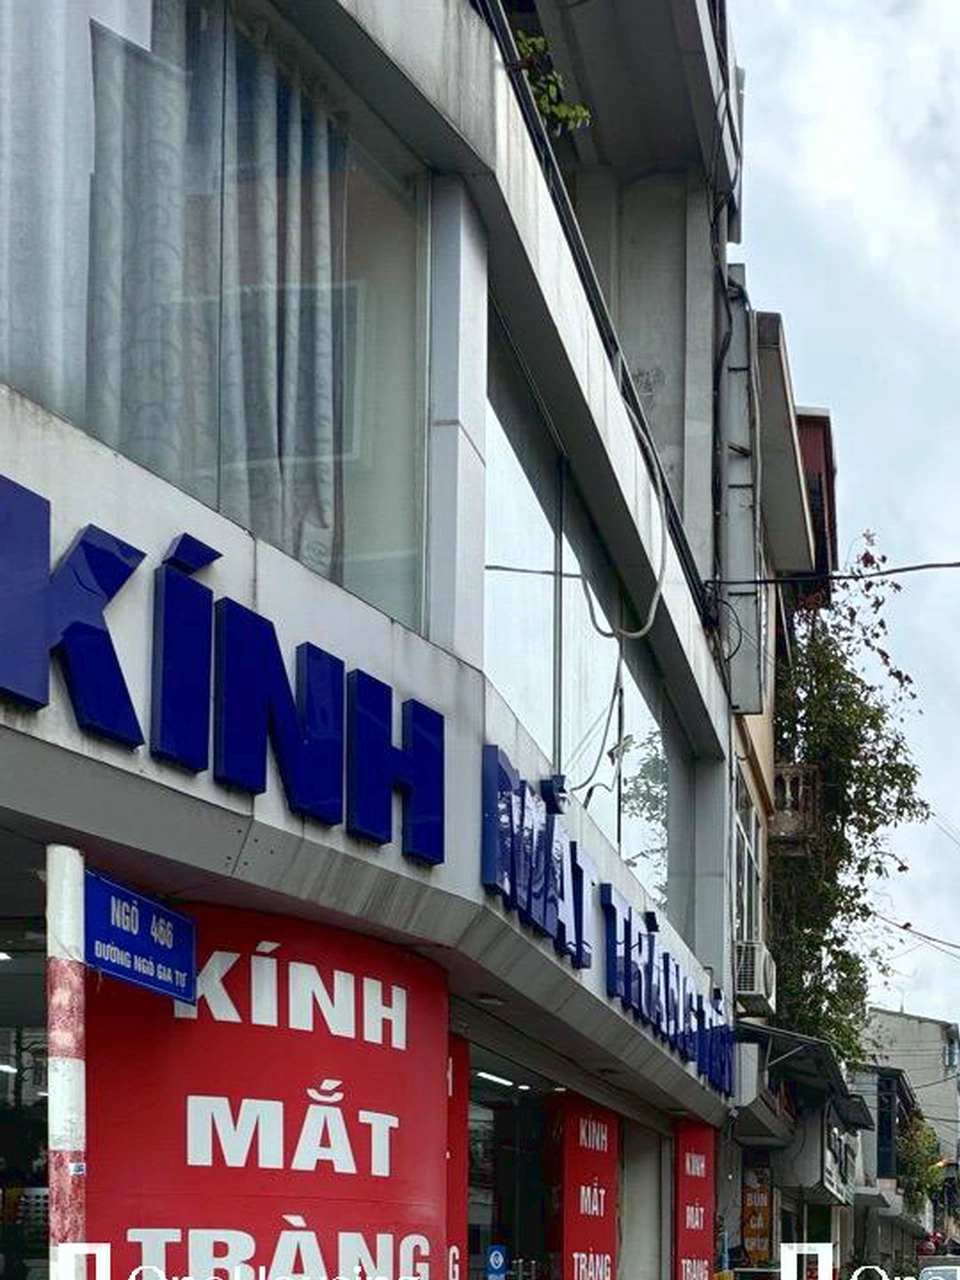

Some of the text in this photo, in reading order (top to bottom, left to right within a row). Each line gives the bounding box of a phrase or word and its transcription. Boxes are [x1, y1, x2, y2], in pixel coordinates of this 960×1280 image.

[0, 474, 445, 866] KÍNH
[174, 940, 407, 1050] KÍNH
[187, 1079, 399, 1177] MẮT
[579, 1114, 608, 1152] KÍNH
[572, 1247, 612, 1280] TRÀNG
